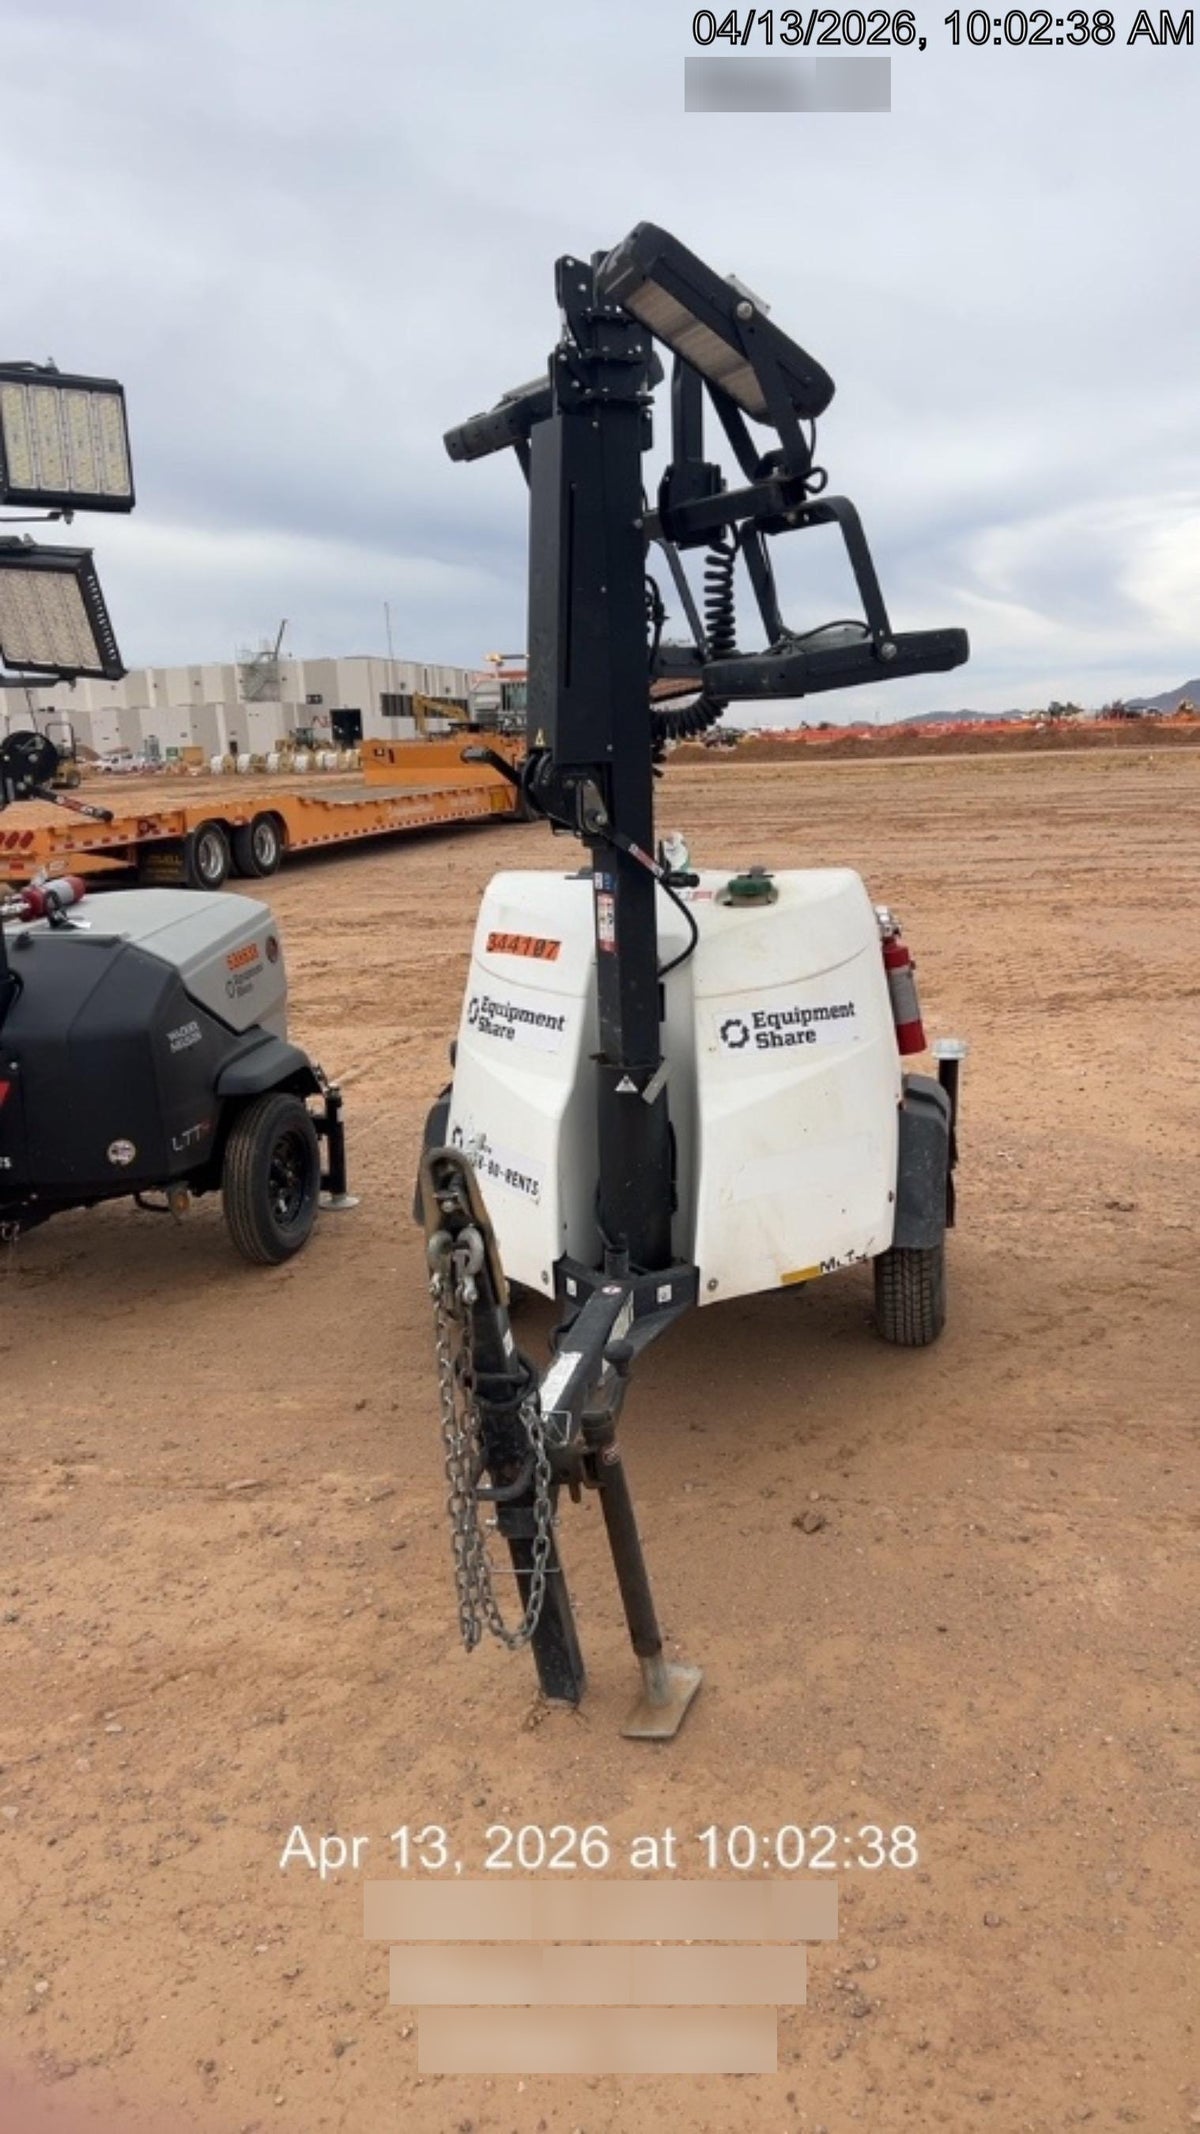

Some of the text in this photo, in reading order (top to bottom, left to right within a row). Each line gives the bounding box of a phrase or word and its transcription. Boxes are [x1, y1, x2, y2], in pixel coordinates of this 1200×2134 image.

[480, 995, 565, 1032] Equipment
[751, 1000, 856, 1030] Equipment
[478, 1016, 516, 1041] Share
[755, 1029, 817, 1050] Share
